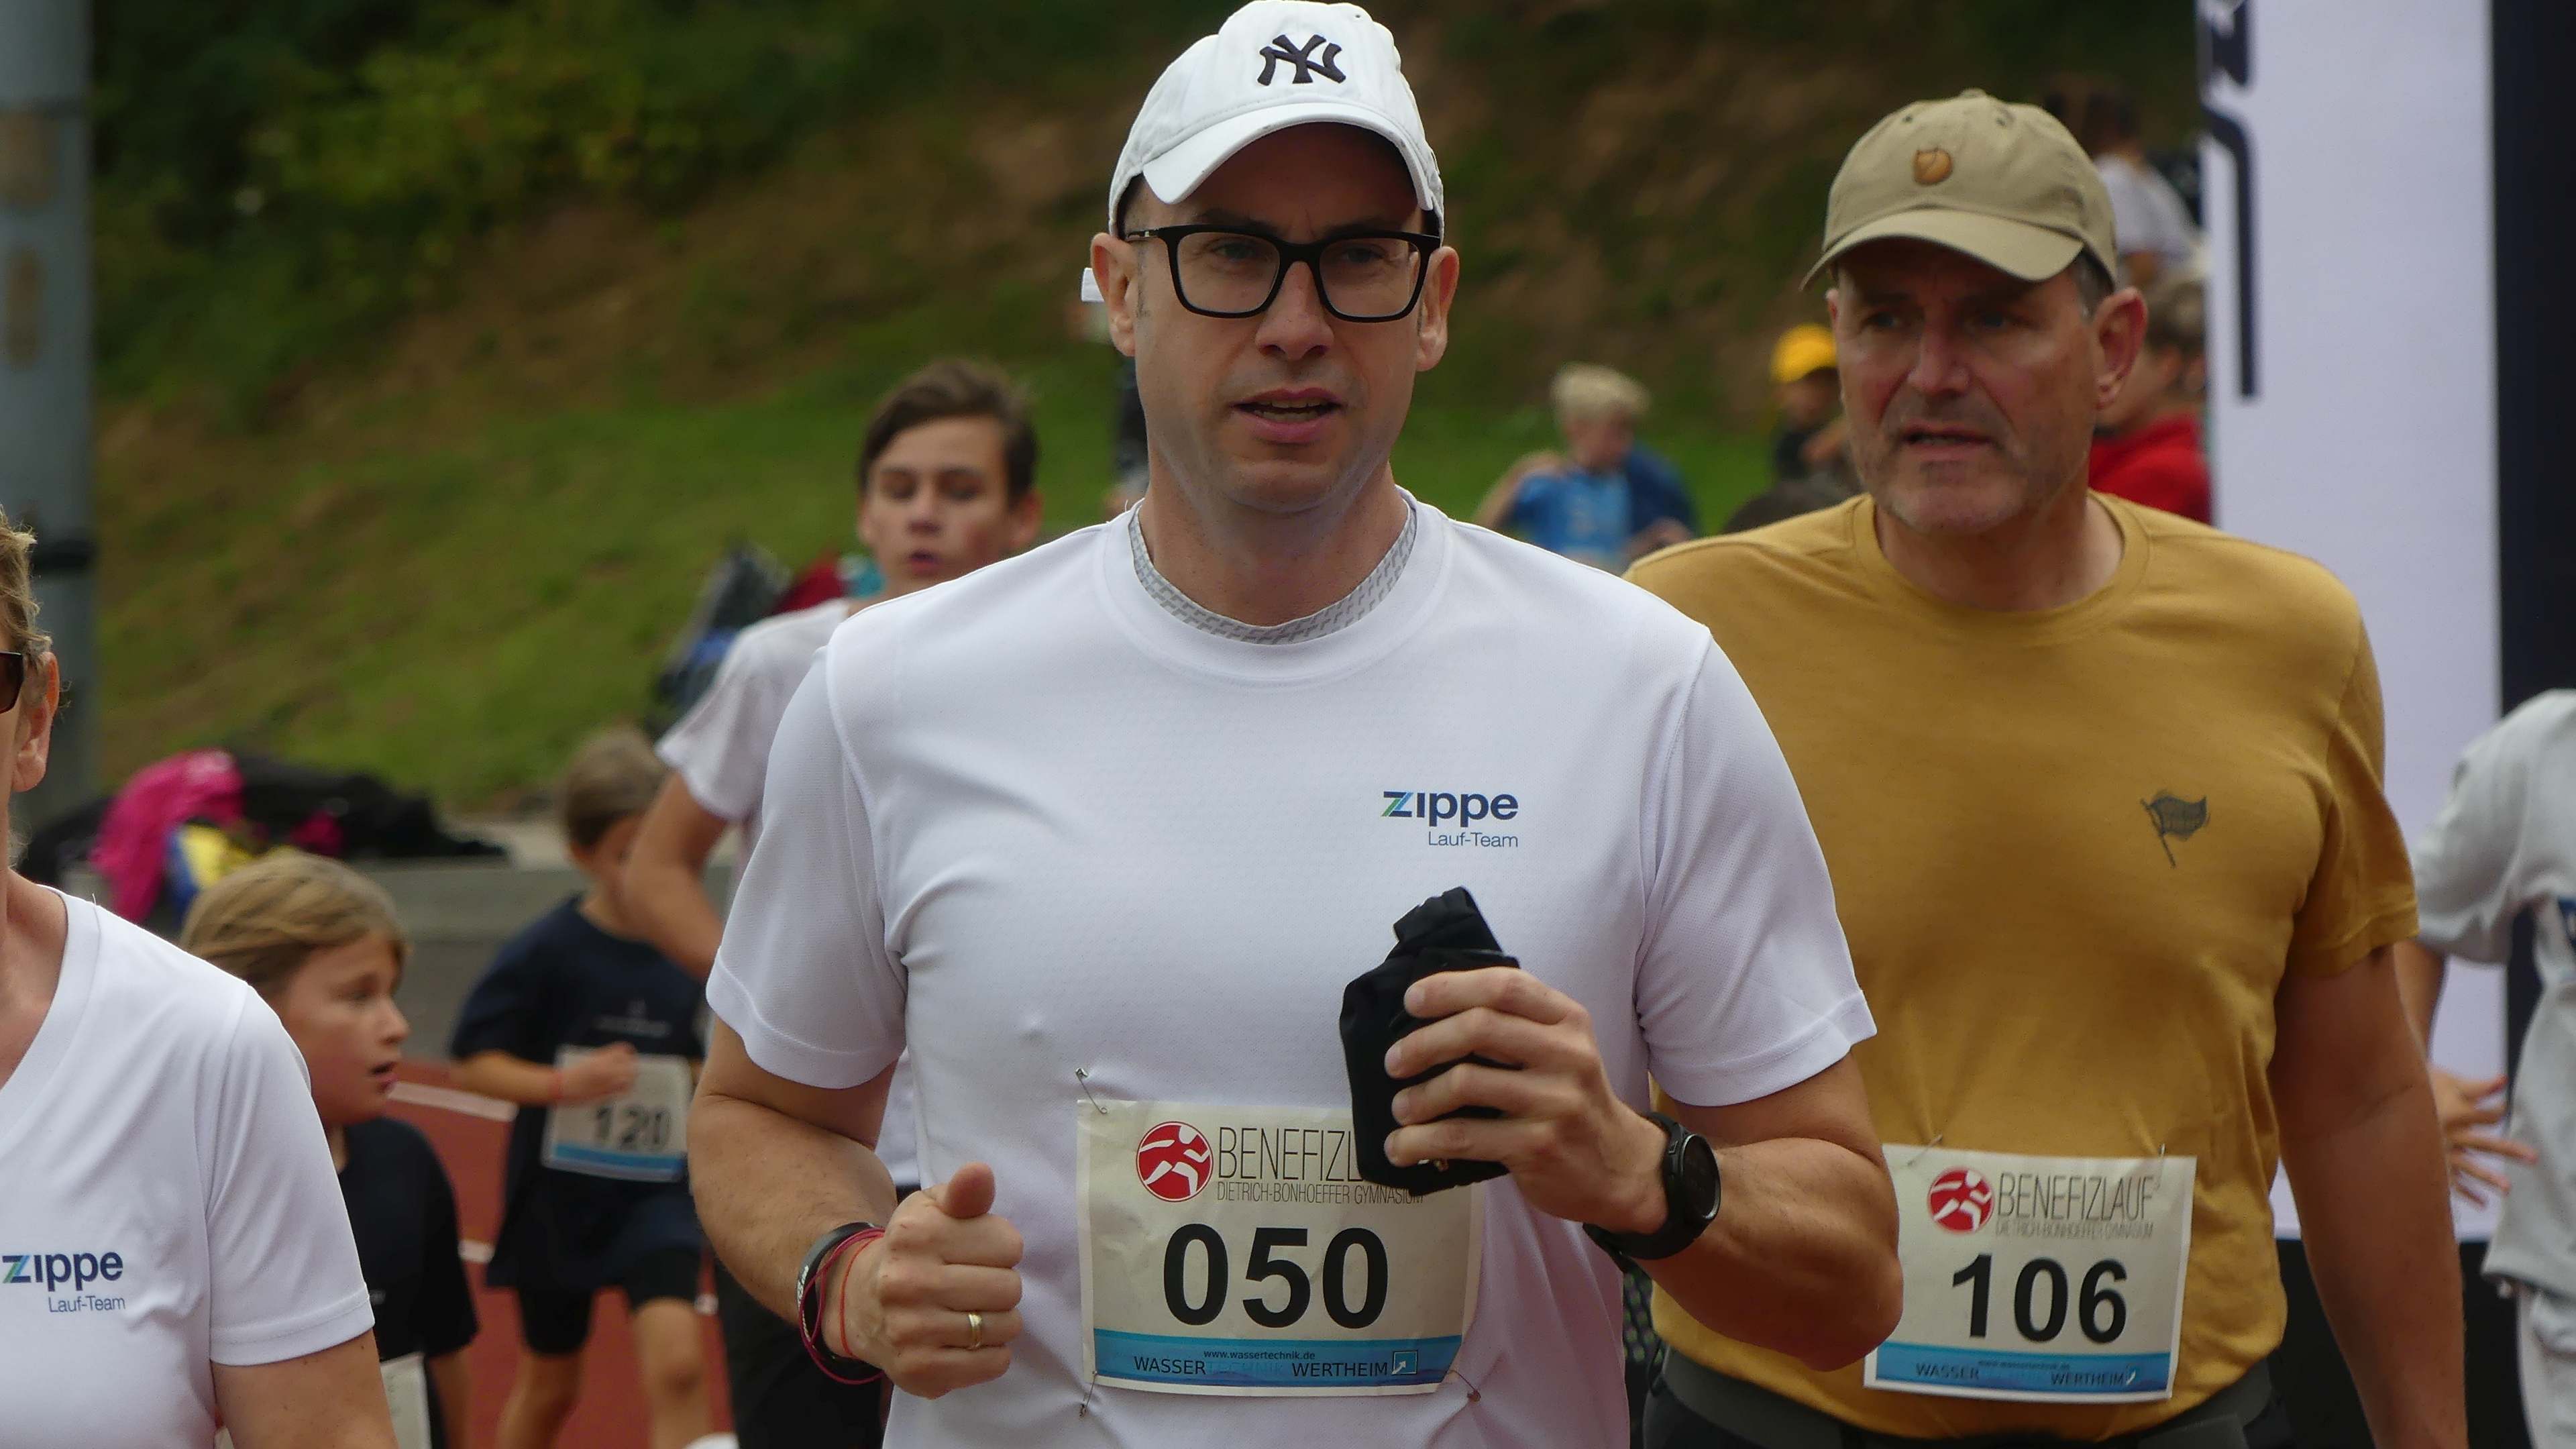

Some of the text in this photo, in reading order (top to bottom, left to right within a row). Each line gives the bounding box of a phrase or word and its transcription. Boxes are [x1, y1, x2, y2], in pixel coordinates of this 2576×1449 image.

[1257, 34, 1346, 86] NY
[1381, 791, 1519, 828] zippe
[1428, 830, 1519, 848] Lauf-Team
[1218, 1126, 1364, 1182] BENEFIZL
[1217, 1181, 1350, 1204] DIETRICH-BONHOEFFER
[1998, 1173, 2154, 1221] BENEFIZLAUF
[2, 1252, 123, 1292] zippe
[1163, 1223, 1389, 1330] 050
[48, 1295, 126, 1313] Lauf-Team
[1951, 1253, 2128, 1344] 106
[1134, 1356, 1206, 1375] WASSER
[1292, 1362, 1388, 1378] WERTHEIM
[1203, 1350, 1316, 1360] www.wassertechnik.de
